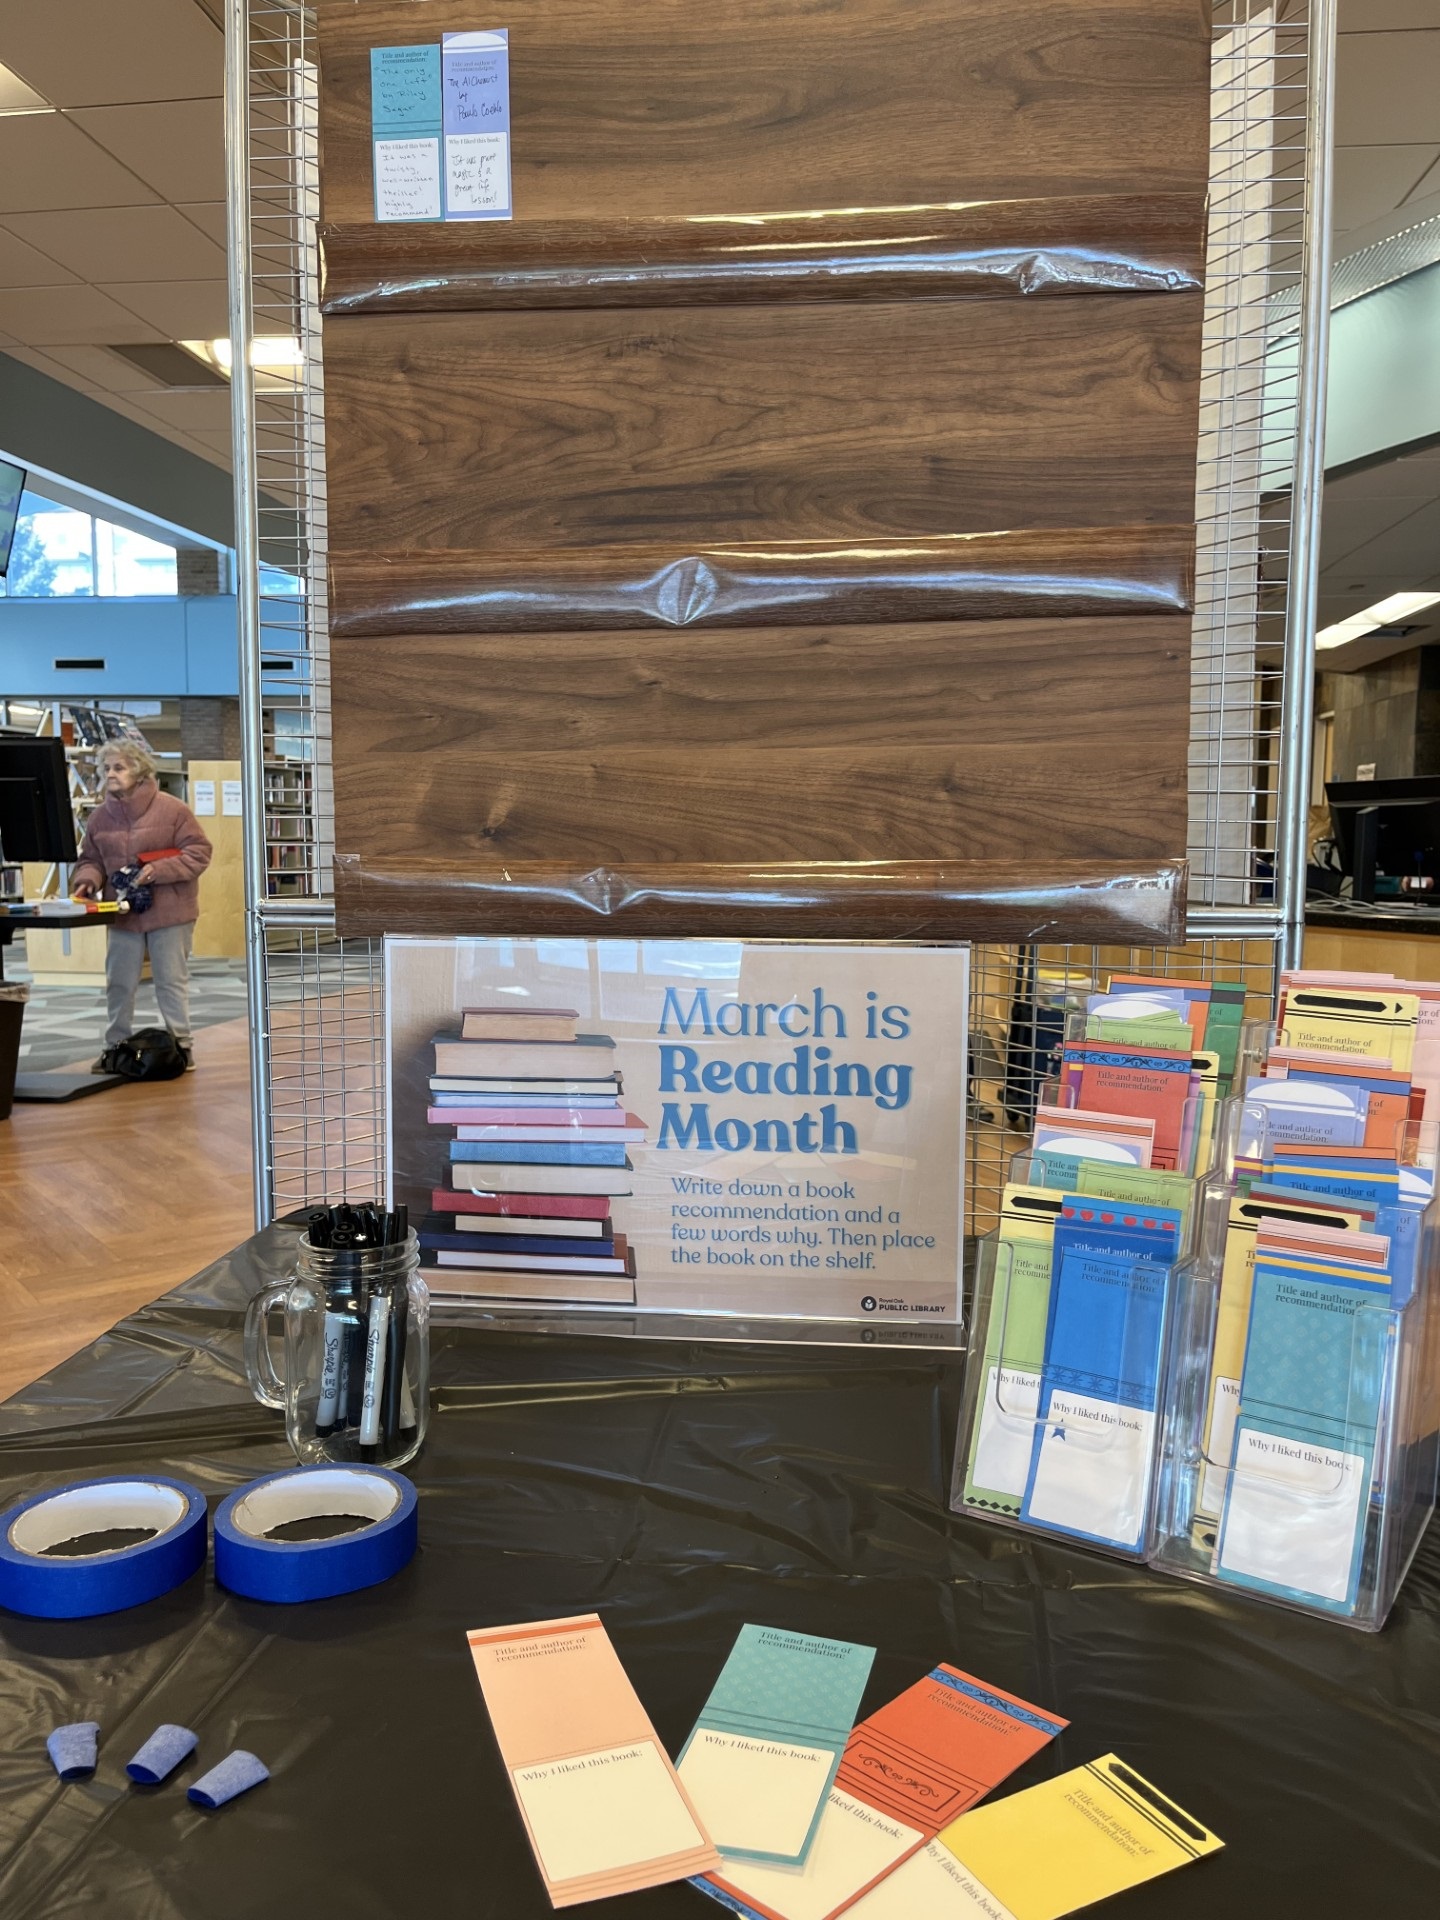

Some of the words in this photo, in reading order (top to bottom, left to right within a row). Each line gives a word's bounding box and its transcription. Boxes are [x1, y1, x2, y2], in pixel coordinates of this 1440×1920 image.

[657, 987, 848, 1038] March
[865, 991, 911, 1039] is
[1112, 1038, 1128, 1046] Title
[1170, 1042, 1178, 1050] of
[1297, 1042, 1368, 1054] recommendation:
[1298, 1032, 1316, 1041] Title
[1317, 1035, 1332, 1044] and
[1334, 1037, 1361, 1048] author
[1363, 1040, 1372, 1048] of
[658, 1045, 913, 1110] Reading
[1096, 1080, 1164, 1092] recommendation:
[1098, 1071, 1116, 1080] Title
[1116, 1073, 1130, 1082] and
[1132, 1074, 1158, 1084] author
[656, 1103, 859, 1154] Month
[1278, 1123, 1293, 1131] and
[1295, 1125, 1322, 1134] author
[1048, 1160, 1066, 1170] Title
[671, 1177, 723, 1195] Write
[729, 1178, 782, 1197] down
[788, 1183, 800, 1197] a
[806, 1180, 855, 1200] book
[1098, 1188, 1115, 1198] Title
[1118, 1191, 1132, 1202] and
[1162, 1198, 1170, 1206] of
[1289, 1181, 1312, 1190] Title
[1313, 1184, 1330, 1192] and
[1332, 1185, 1364, 1196] author
[1366, 1189, 1378, 1198] of
[671, 1202, 839, 1222] recommendation
[845, 1206, 882, 1223] and
[888, 1210, 900, 1224] a
[671, 1224, 705, 1241] few
[711, 1226, 771, 1244] words
[776, 1227, 822, 1248] why.
[827, 1228, 877, 1247] Then
[882, 1230, 935, 1250] place
[671, 1247, 701, 1264] the
[707, 1247, 755, 1266] book
[760, 1252, 784, 1267] on
[789, 1250, 820, 1268] the
[825, 1251, 876, 1270] shelf.
[1073, 1242, 1092, 1250] Title
[1093, 1246, 1111, 1254] and
[1112, 1248, 1142, 1259] author
[1142, 1252, 1154, 1260] of
[1016, 1259, 1032, 1268] Title
[1034, 1262, 1048, 1271] and
[1082, 1264, 1101, 1274] Title
[1104, 1268, 1119, 1277] and
[1276, 1283, 1298, 1295] Title
[1300, 1288, 1318, 1300] and
[1320, 1291, 1354, 1306] author
[879, 1304, 908, 1312] PUBLIC
[1016, 1376, 1036, 1388] liked
[1052, 1402, 1072, 1415] Why
[1078, 1408, 1099, 1421] liked
[1100, 1414, 1116, 1424] this
[1118, 1418, 1144, 1432] book:
[1248, 1438, 1269, 1451] Why
[1272, 1444, 1276, 1452] I
[1277, 1444, 1302, 1458] liked
[1304, 1451, 1322, 1464] this
[494, 1648, 517, 1656] Title
[520, 1643, 538, 1652] and
[540, 1639, 574, 1650] author
[576, 1636, 586, 1644] of
[496, 1644, 586, 1662] recommendation:
[758, 1638, 846, 1660] recommendation:
[761, 1632, 782, 1640] Title
[784, 1637, 804, 1645] and
[806, 1641, 838, 1652] author
[928, 1693, 1012, 1736] recommendation:
[934, 1688, 954, 1700] Title
[956, 1700, 977, 1711] and
[975, 1706, 1008, 1726] author
[1010, 1724, 1022, 1732] of
[705, 1735, 727, 1748] Why
[737, 1742, 764, 1752] liked
[766, 1746, 788, 1756] this
[790, 1750, 820, 1762] book:
[522, 1770, 548, 1781] Why
[557, 1761, 586, 1774] liked
[588, 1756, 610, 1768] this
[612, 1750, 643, 1762] book:
[828, 1793, 854, 1812] liked
[852, 1808, 872, 1823] this
[873, 1818, 904, 1839] book:
[1064, 1793, 1139, 1858] recommendation:
[1073, 1788, 1094, 1806] Title
[1092, 1806, 1113, 1822] and
[1110, 1820, 1140, 1846] author
[1138, 1846, 1155, 1856] of
[941, 1859, 967, 1884] liked
[962, 1881, 980, 1900] this
